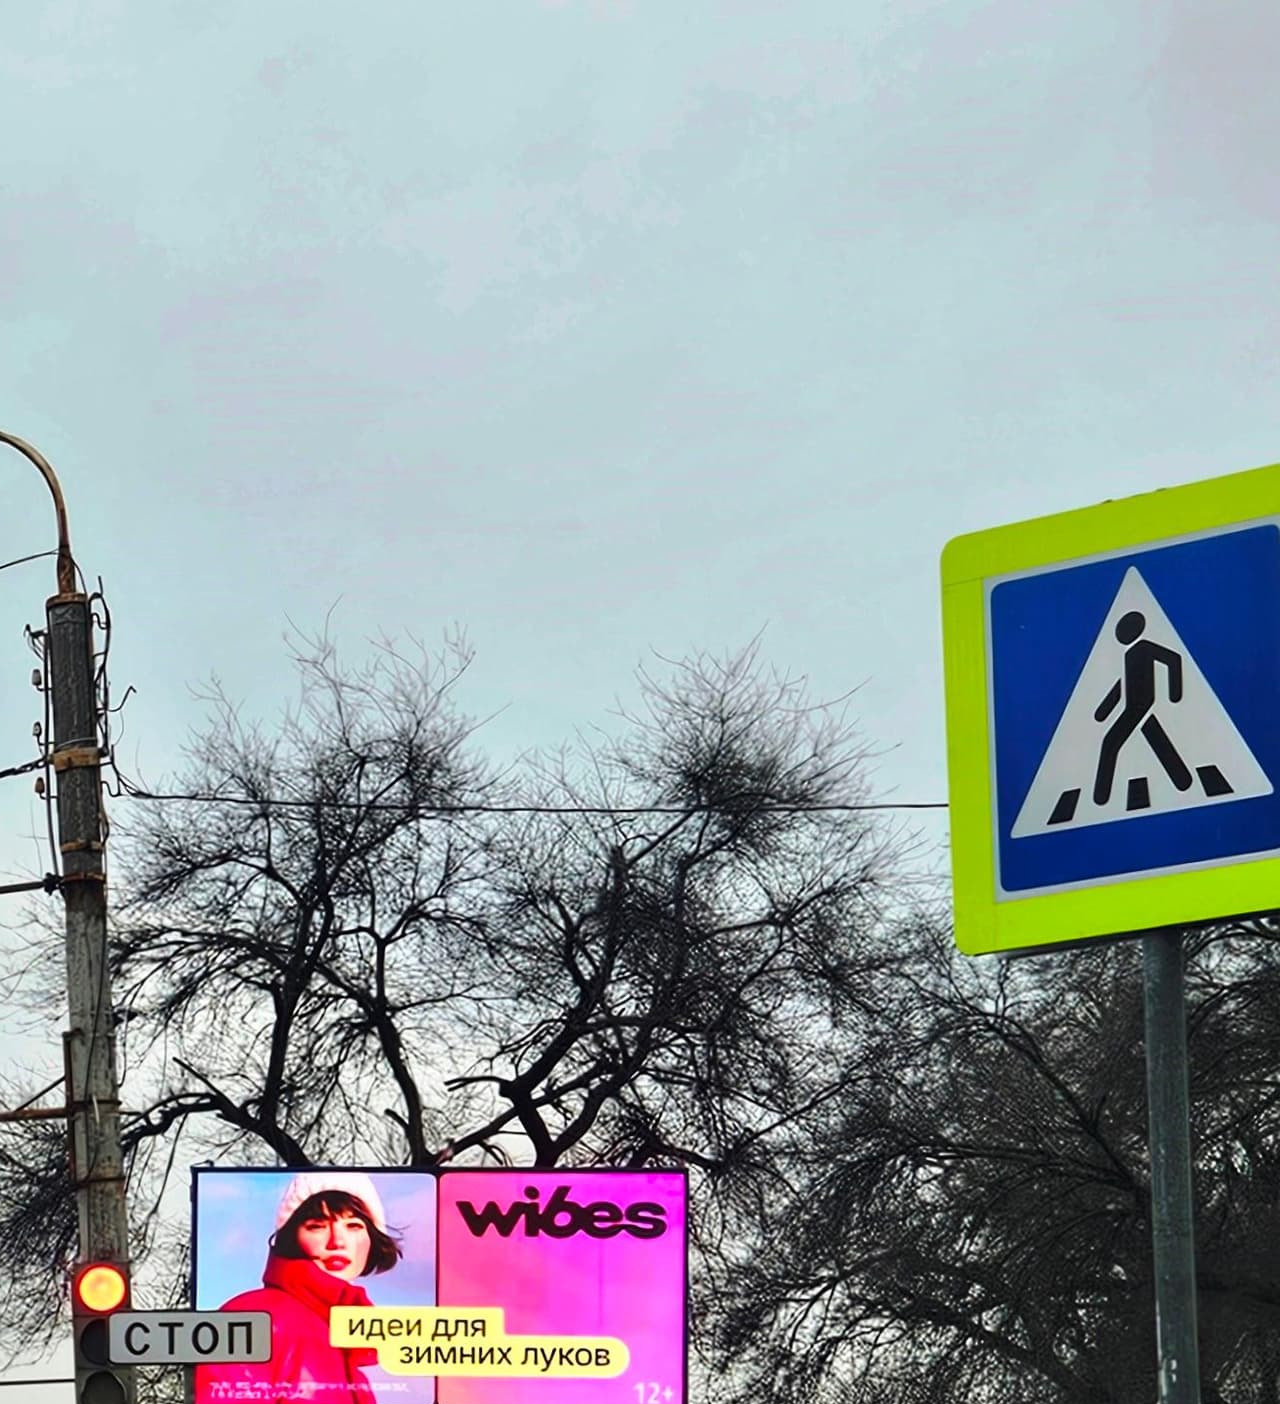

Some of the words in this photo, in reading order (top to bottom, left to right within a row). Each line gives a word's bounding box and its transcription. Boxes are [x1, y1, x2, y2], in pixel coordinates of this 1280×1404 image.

[456, 1185, 668, 1239] wibes
[124, 1321, 253, 1355] СТОП
[348, 1318, 422, 1340] идеи
[431, 1318, 487, 1341] для
[399, 1346, 512, 1366] зимних
[521, 1347, 611, 1372] луков
